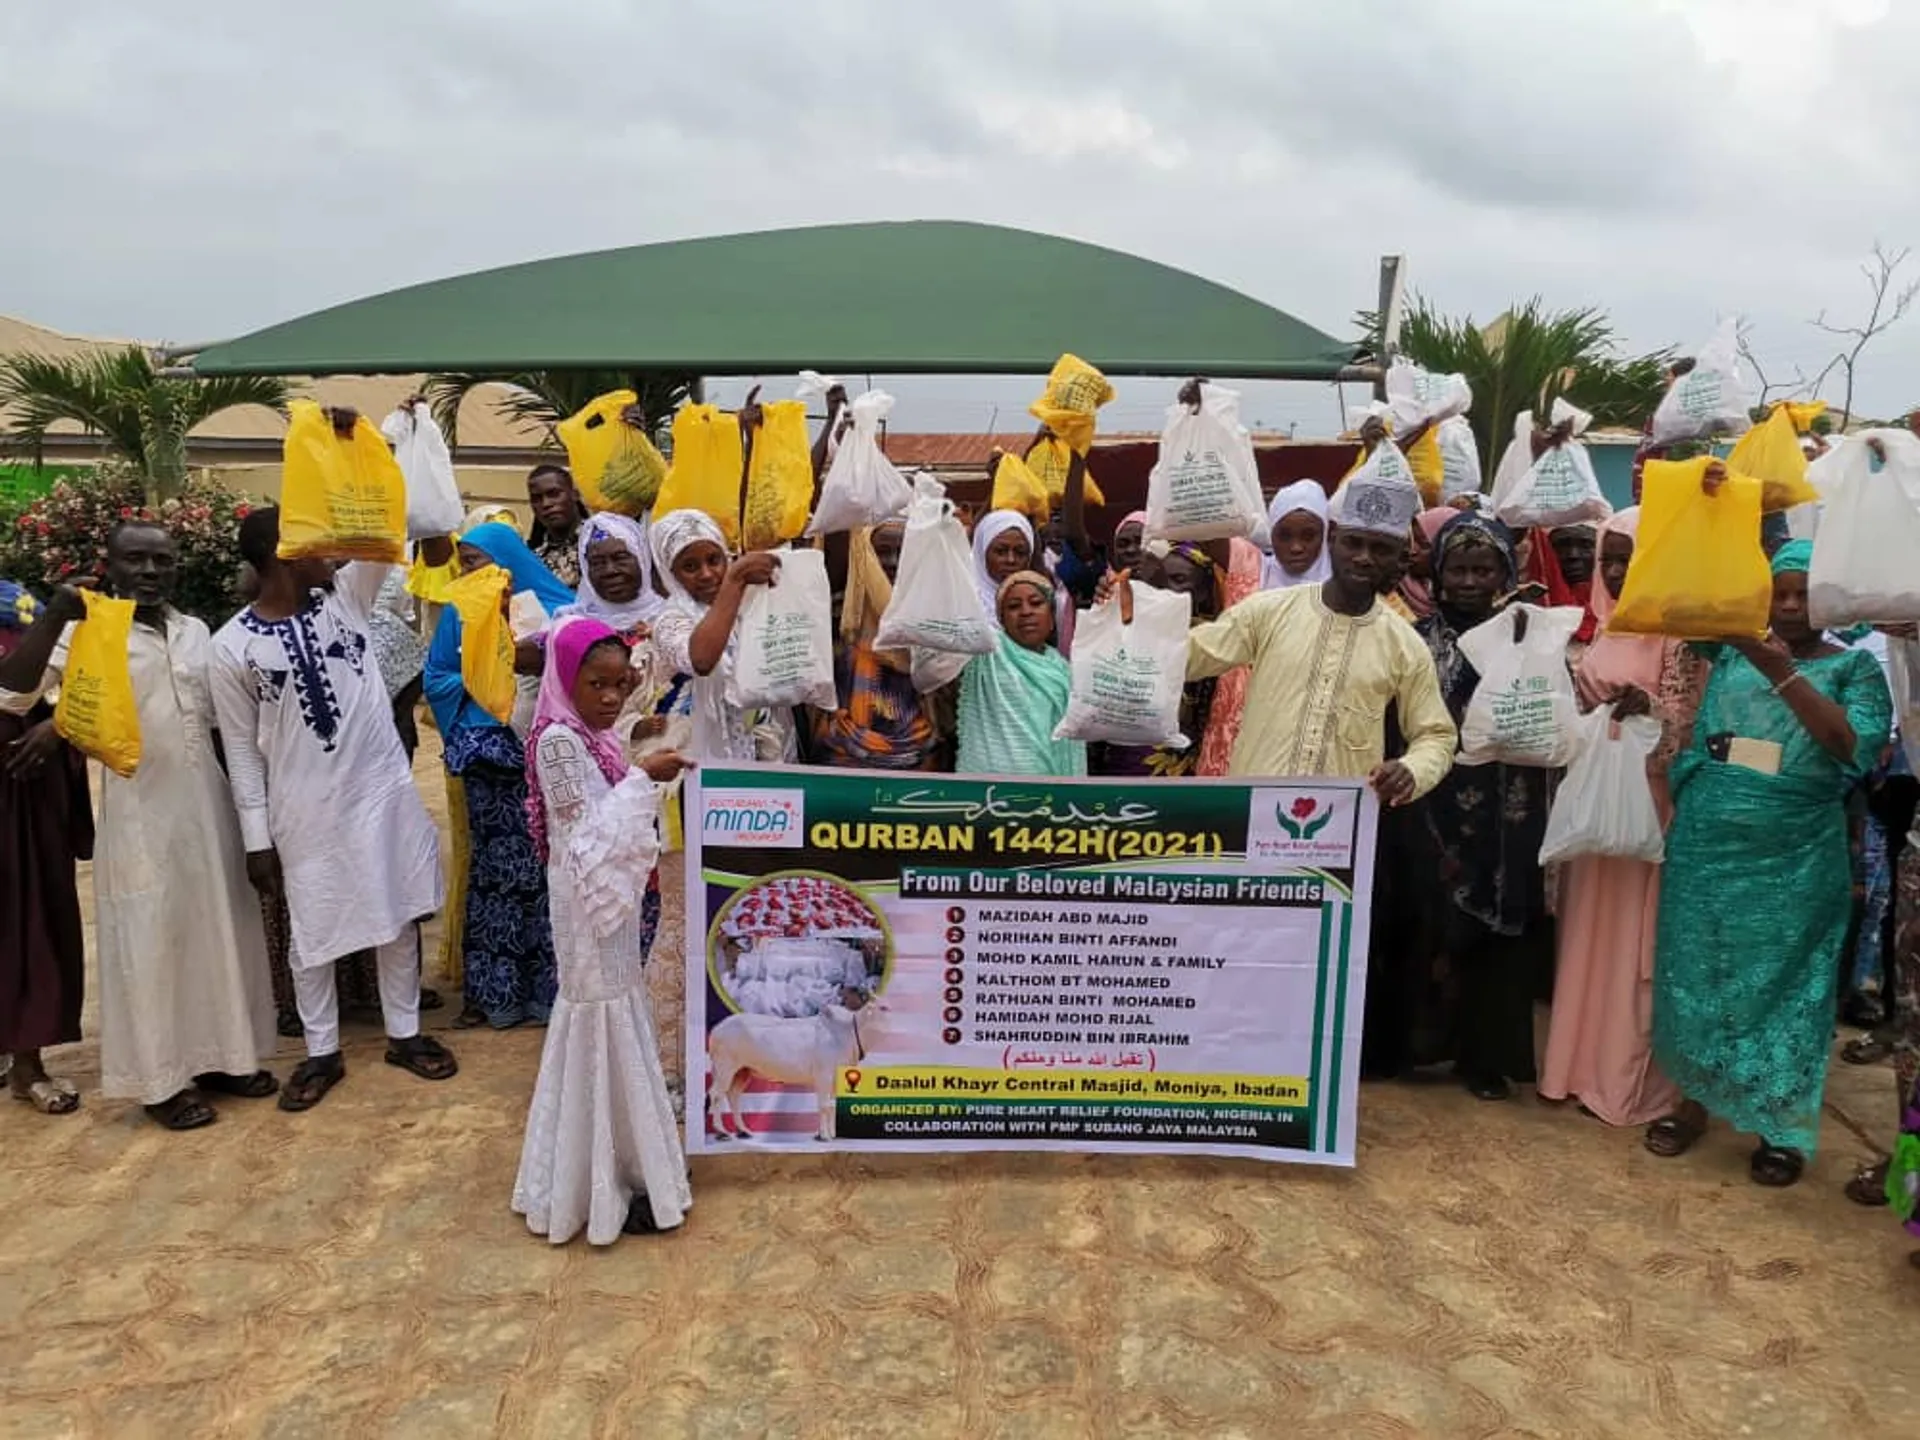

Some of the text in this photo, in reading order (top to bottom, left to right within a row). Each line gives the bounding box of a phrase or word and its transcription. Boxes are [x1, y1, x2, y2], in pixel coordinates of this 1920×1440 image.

[704, 809, 788, 831] MINDA
[810, 821, 1224, 861] QURBAN 1442H(2021)
[902, 869, 1321, 903] From Our Beloved Malaysian Friends
[978, 910, 1053, 923] MAZIDAH
[1058, 912, 1092, 924] ABD
[1096, 913, 1149, 925] MAJID
[977, 931, 1054, 944] NORIHAN
[1059, 933, 1104, 946] BINTI
[1108, 935, 1178, 947] AFFANDI
[977, 951, 1026, 964] MOHD
[1031, 953, 1082, 966] KAMIL
[1087, 955, 1145, 967] HARUN
[1150, 956, 1163, 968] &
[1168, 957, 1226, 969] FAMILY
[976, 973, 1055, 986] KALTHOM
[1061, 975, 1081, 987] BT
[1087, 976, 1171, 989] MOHAMED
[975, 993, 1054, 1006] RATHUAN
[1059, 995, 1103, 1006] BINTI
[1112, 996, 1196, 1009] MOHAMED
[975, 1011, 1050, 1023] HAMIDAH
[1055, 1012, 1104, 1025] MOHD
[1108, 1013, 1154, 1025] RIJAL
[974, 1030, 1081, 1043] SHAHRUDDIN
[1086, 1032, 1115, 1044] BIN
[1119, 1033, 1190, 1046] IBRAHIM
[876, 1075, 1299, 1098] Daalul Khayr Central Masjid, Moniya, Ibadan
[850, 1103, 1294, 1123] ORGANIZED BY: PURE HEART RELIEF FOUNDATION, NIGERIA IN
[884, 1121, 1258, 1138] COLLABORATION WITH PMP SUBANG JAYA MALAYSIA
